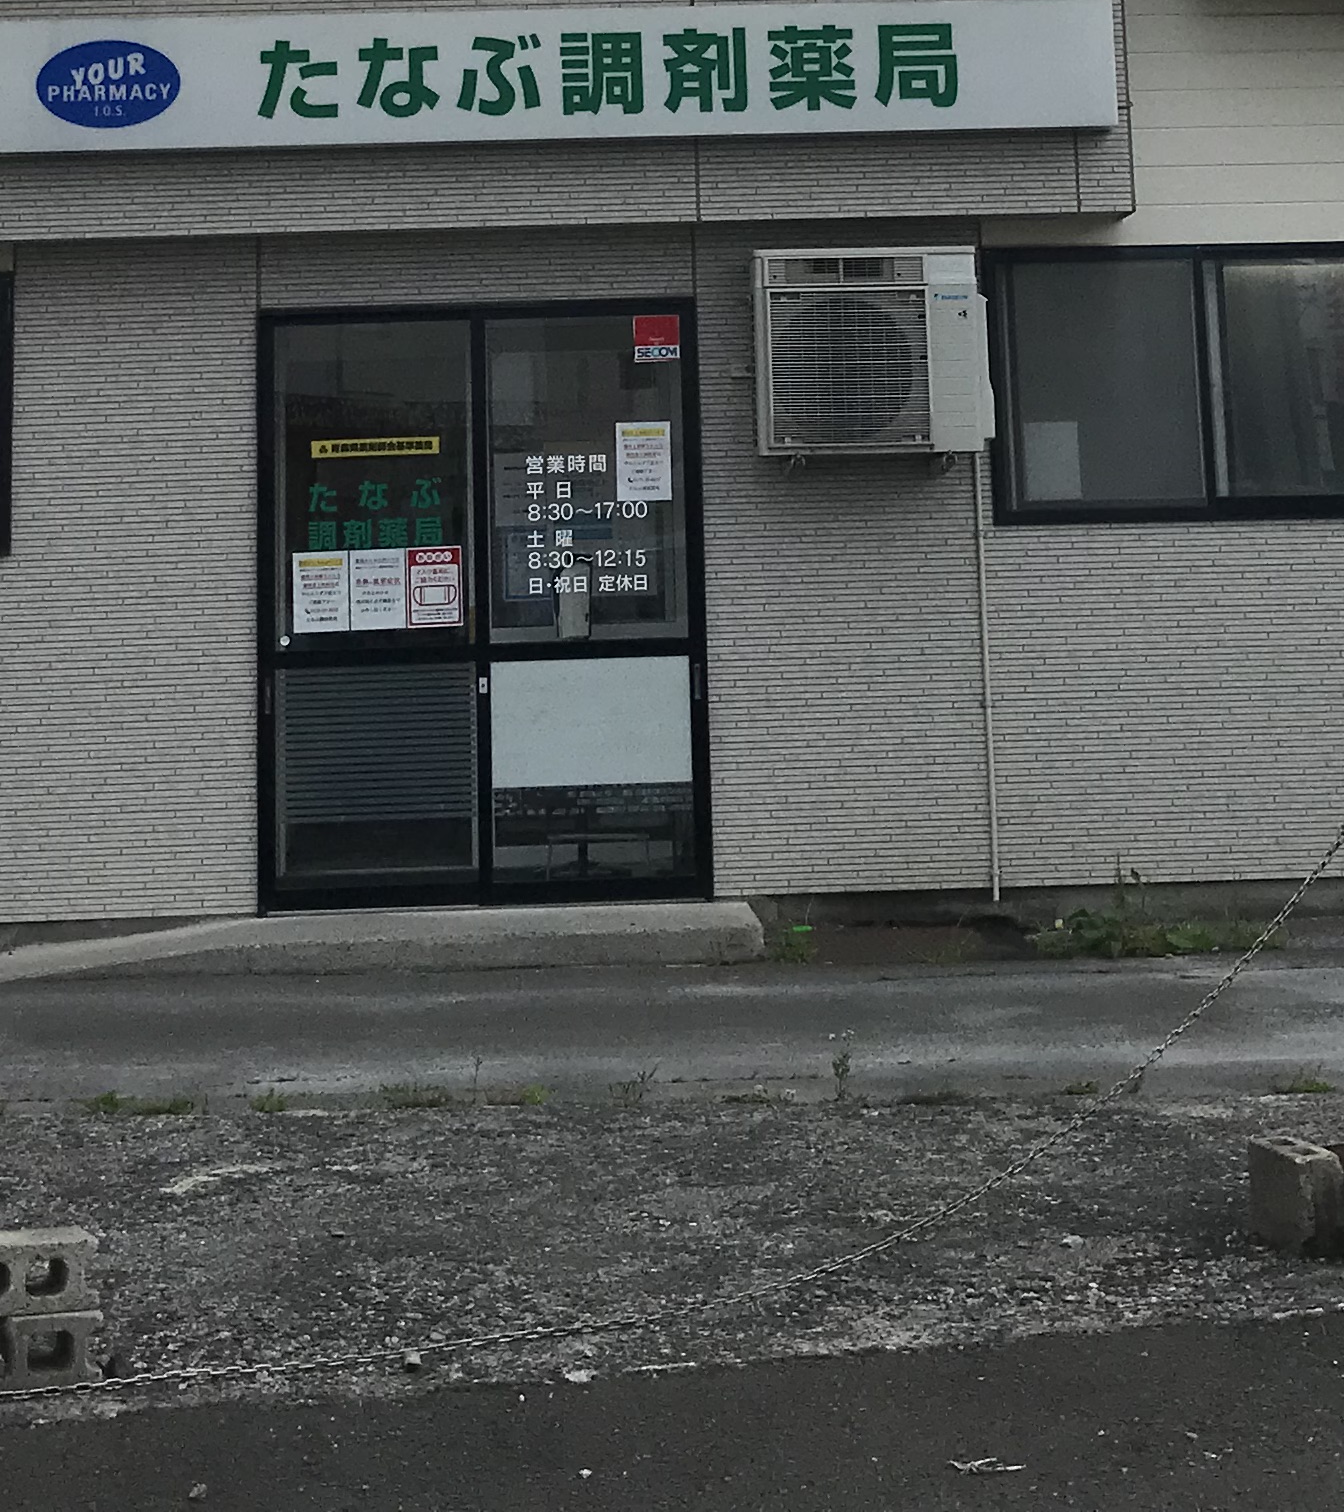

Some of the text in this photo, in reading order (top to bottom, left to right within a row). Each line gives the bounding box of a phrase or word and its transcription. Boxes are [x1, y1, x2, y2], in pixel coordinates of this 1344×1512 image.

[70, 52, 146, 90] YOUR
[257, 24, 960, 119] たなぶ調剤薬局
[47, 83, 171, 102] PHARMACY
[637, 347, 677, 358] SECOM
[526, 454, 607, 474] 営業時間
[309, 477, 442, 512] たなぶ
[526, 481, 571, 499] 平日
[308, 517, 443, 550] 調剤薬局
[527, 530, 573, 548] 土曜
[598, 574, 647, 592] 定休日
